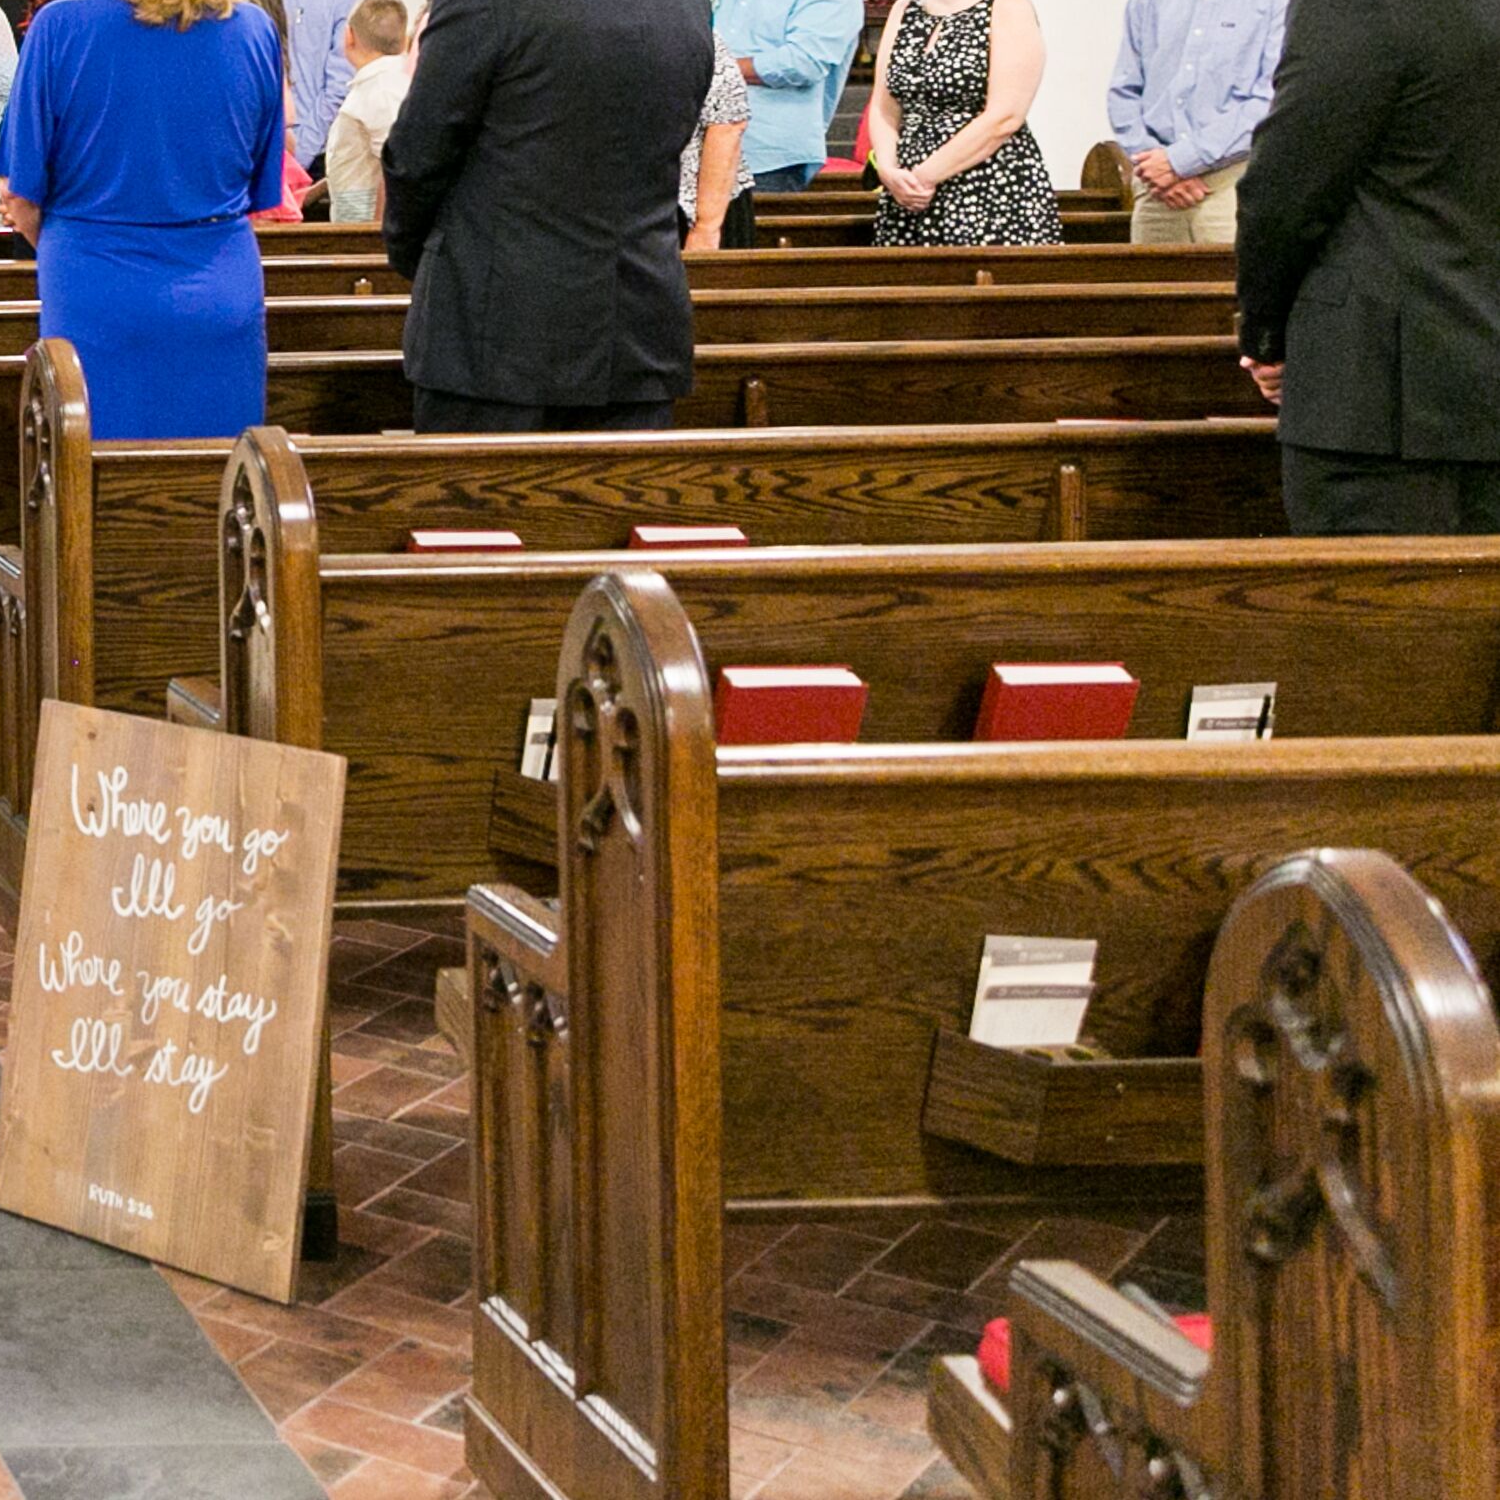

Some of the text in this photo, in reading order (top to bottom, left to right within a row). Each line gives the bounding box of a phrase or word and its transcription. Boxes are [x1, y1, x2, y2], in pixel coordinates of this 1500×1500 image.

[70, 762, 290, 875] Where you go
[186, 893, 246, 956] go
[38, 930, 278, 1056] Where you stay
[142, 1036, 230, 1114] stay
[87, 1183, 123, 1210] RUTH
